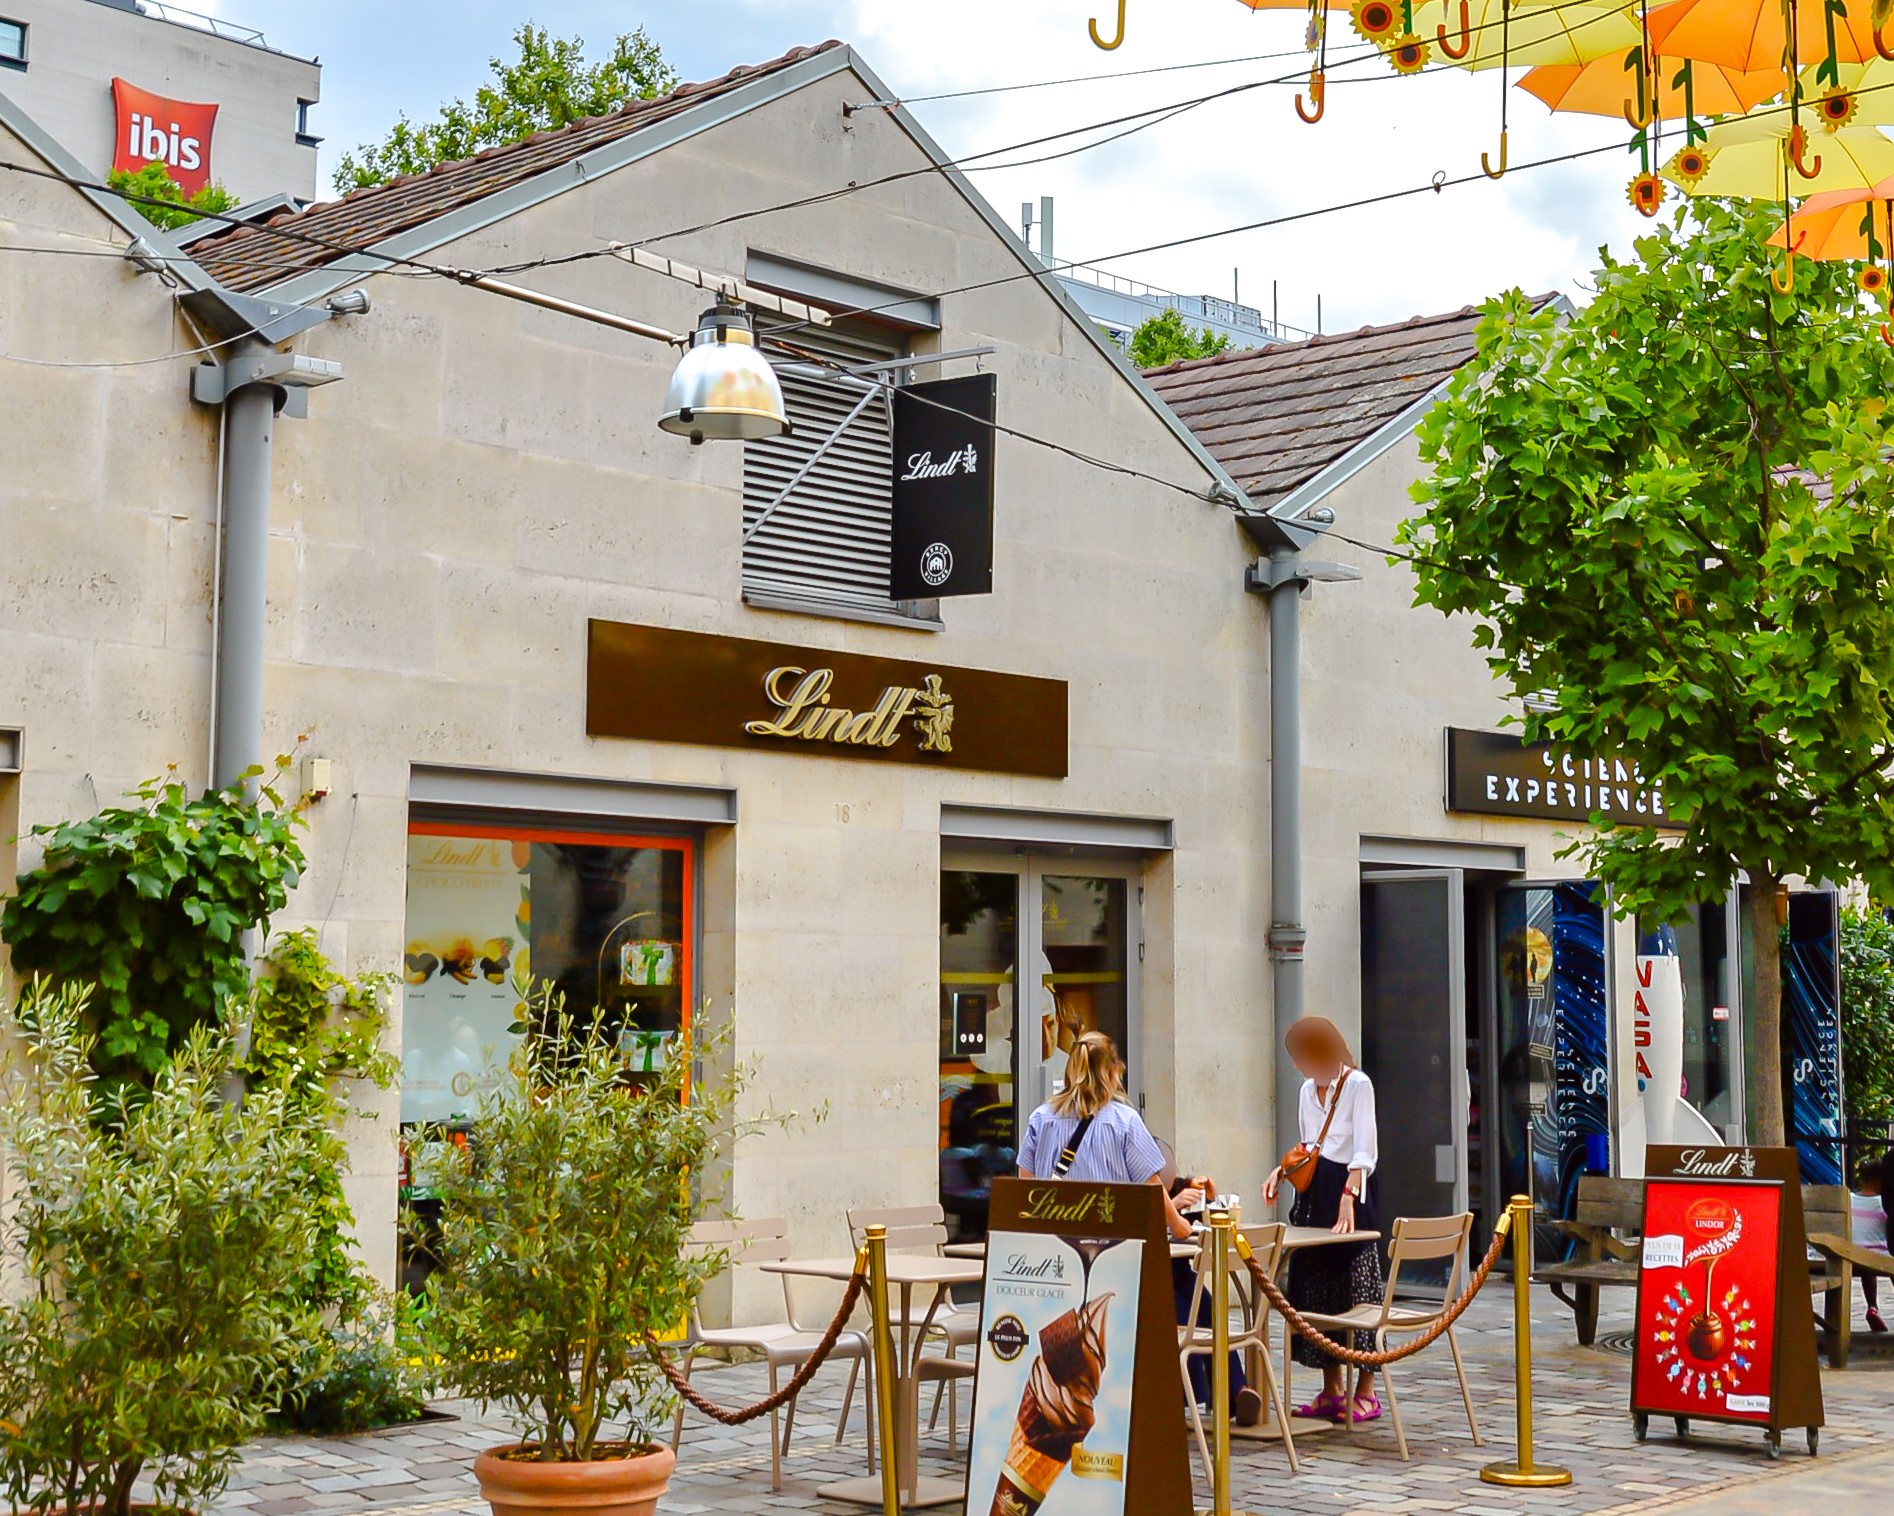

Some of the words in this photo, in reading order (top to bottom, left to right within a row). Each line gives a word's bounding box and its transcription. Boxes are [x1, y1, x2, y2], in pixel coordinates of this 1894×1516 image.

[130, 112, 201, 170] ibis
[901, 450, 963, 480] Lindt
[745, 666, 917, 747] Lindt
[835, 803, 850, 824] 18
[421, 840, 486, 865] Lindt
[1672, 1149, 1739, 1176] Lindt
[1019, 1187, 1097, 1222] Lindt
[1695, 1220, 1725, 1229] LINDOR
[1002, 1254, 1053, 1278] Lindt
[1645, 1253, 1679, 1263] RECETTES
[996, 1285, 1035, 1296] DOUCEUR
[1078, 1453, 1116, 1467] NOUVEAU
